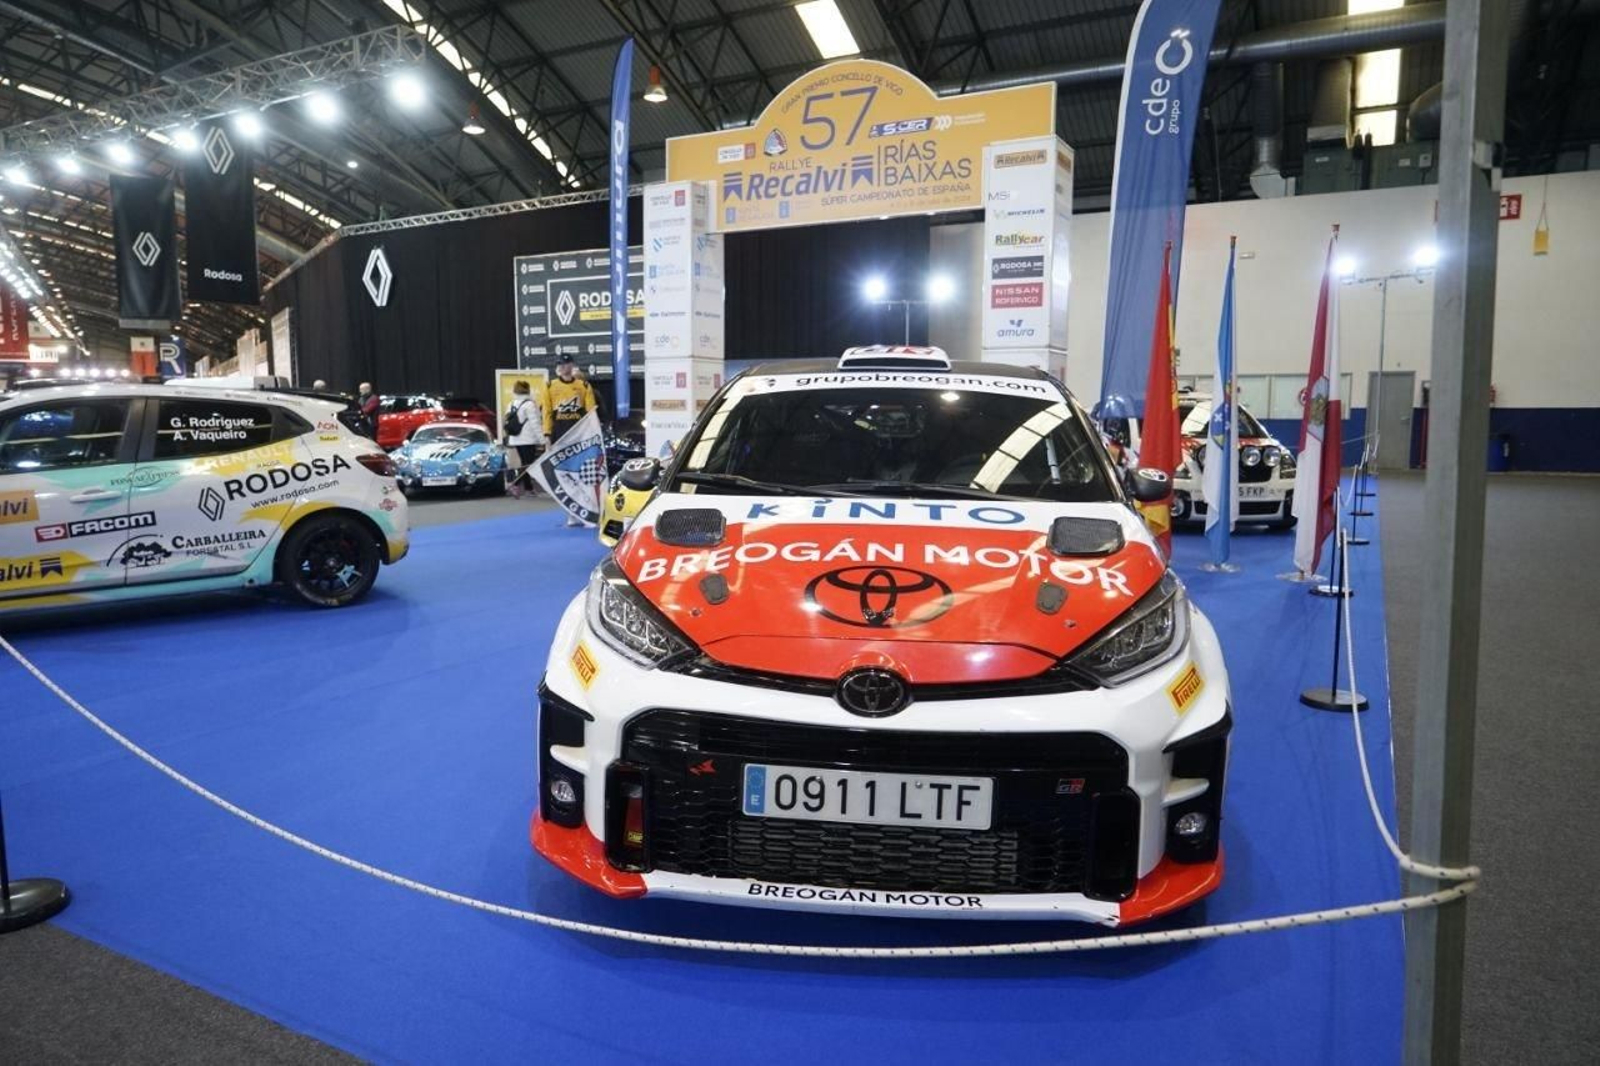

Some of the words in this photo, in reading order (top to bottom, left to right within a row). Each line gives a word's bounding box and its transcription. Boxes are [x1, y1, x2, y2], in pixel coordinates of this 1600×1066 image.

[782, 92, 801, 114] GRAN
[802, 77, 830, 96] PREMIO
[831, 70, 872, 84] CONCELLO
[875, 75, 885, 86] DE
[885, 79, 904, 97] VIGO
[800, 85, 880, 151] 57
[1168, 100, 1180, 134] grupo
[770, 156, 813, 174] RALLYE
[884, 139, 937, 166] RÍAS
[746, 162, 847, 201] Recalvi
[884, 158, 973, 188] BAIXAS
[850, 187, 915, 204] CAMPEONATO
[917, 186, 930, 196] DE
[933, 181, 972, 194] ESPAÑA
[204, 268, 243, 282] Rodosa
[579, 289, 644, 307] RODSA
[995, 287, 1040, 296] NISSAN
[996, 328, 1035, 338] amura
[796, 374, 1047, 394] grupobreogan.com
[170, 417, 186, 429] G.
[189, 416, 255, 431] Rodriguez
[173, 432, 187, 441] A.
[190, 430, 247, 443] Vaqueiro
[224, 454, 352, 501] RODOSA
[250, 479, 339, 509] www.rodosa.com
[554, 485, 589, 518] VIGO
[172, 529, 266, 549] CARBALLEIRA
[186, 545, 237, 557] FORESTAL
[637, 538, 904, 583] BREOGÁN
[924, 544, 1134, 597] MOTOR
[572, 645, 597, 685] PIRELLI
[1171, 667, 1202, 708] PIRELLI
[774, 773, 876, 817] 0911
[899, 781, 981, 822] LTF
[886, 892, 984, 907] MOTOR
